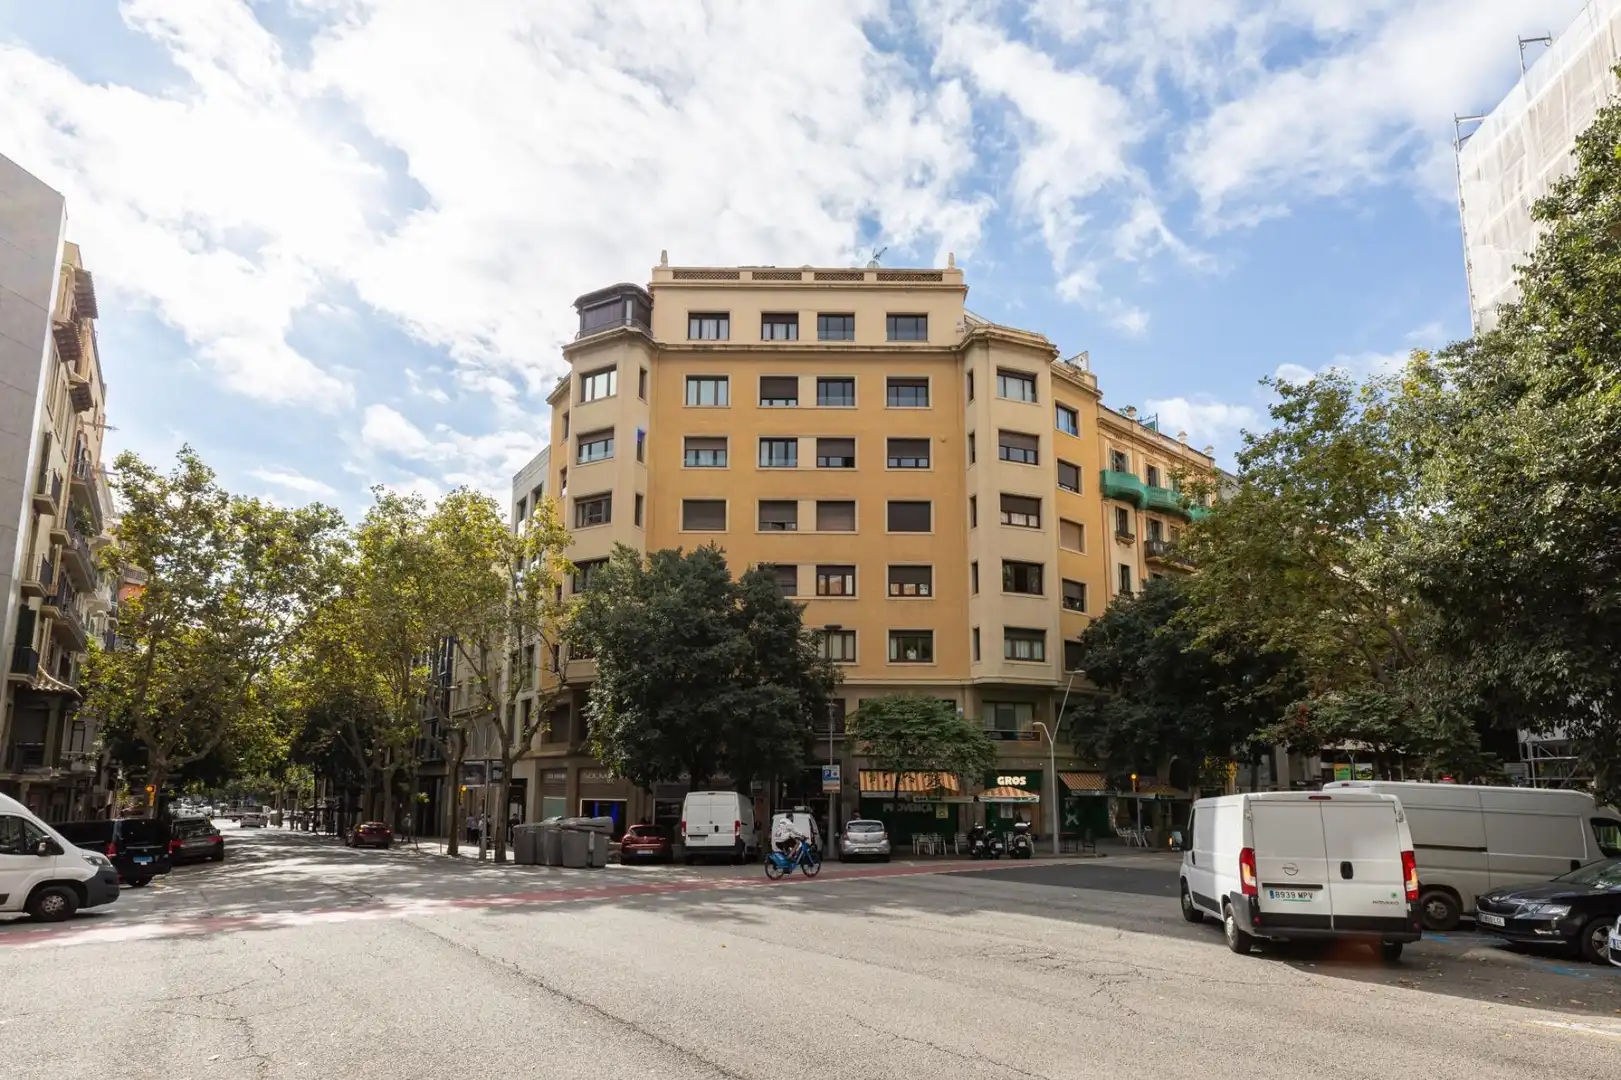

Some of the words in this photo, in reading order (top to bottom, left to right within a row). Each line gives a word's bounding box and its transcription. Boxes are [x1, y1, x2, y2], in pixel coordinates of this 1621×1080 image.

[996, 775, 1027, 786] GROS
[1275, 891, 1296, 899] 8939
[1297, 892, 1313, 900] MPV
